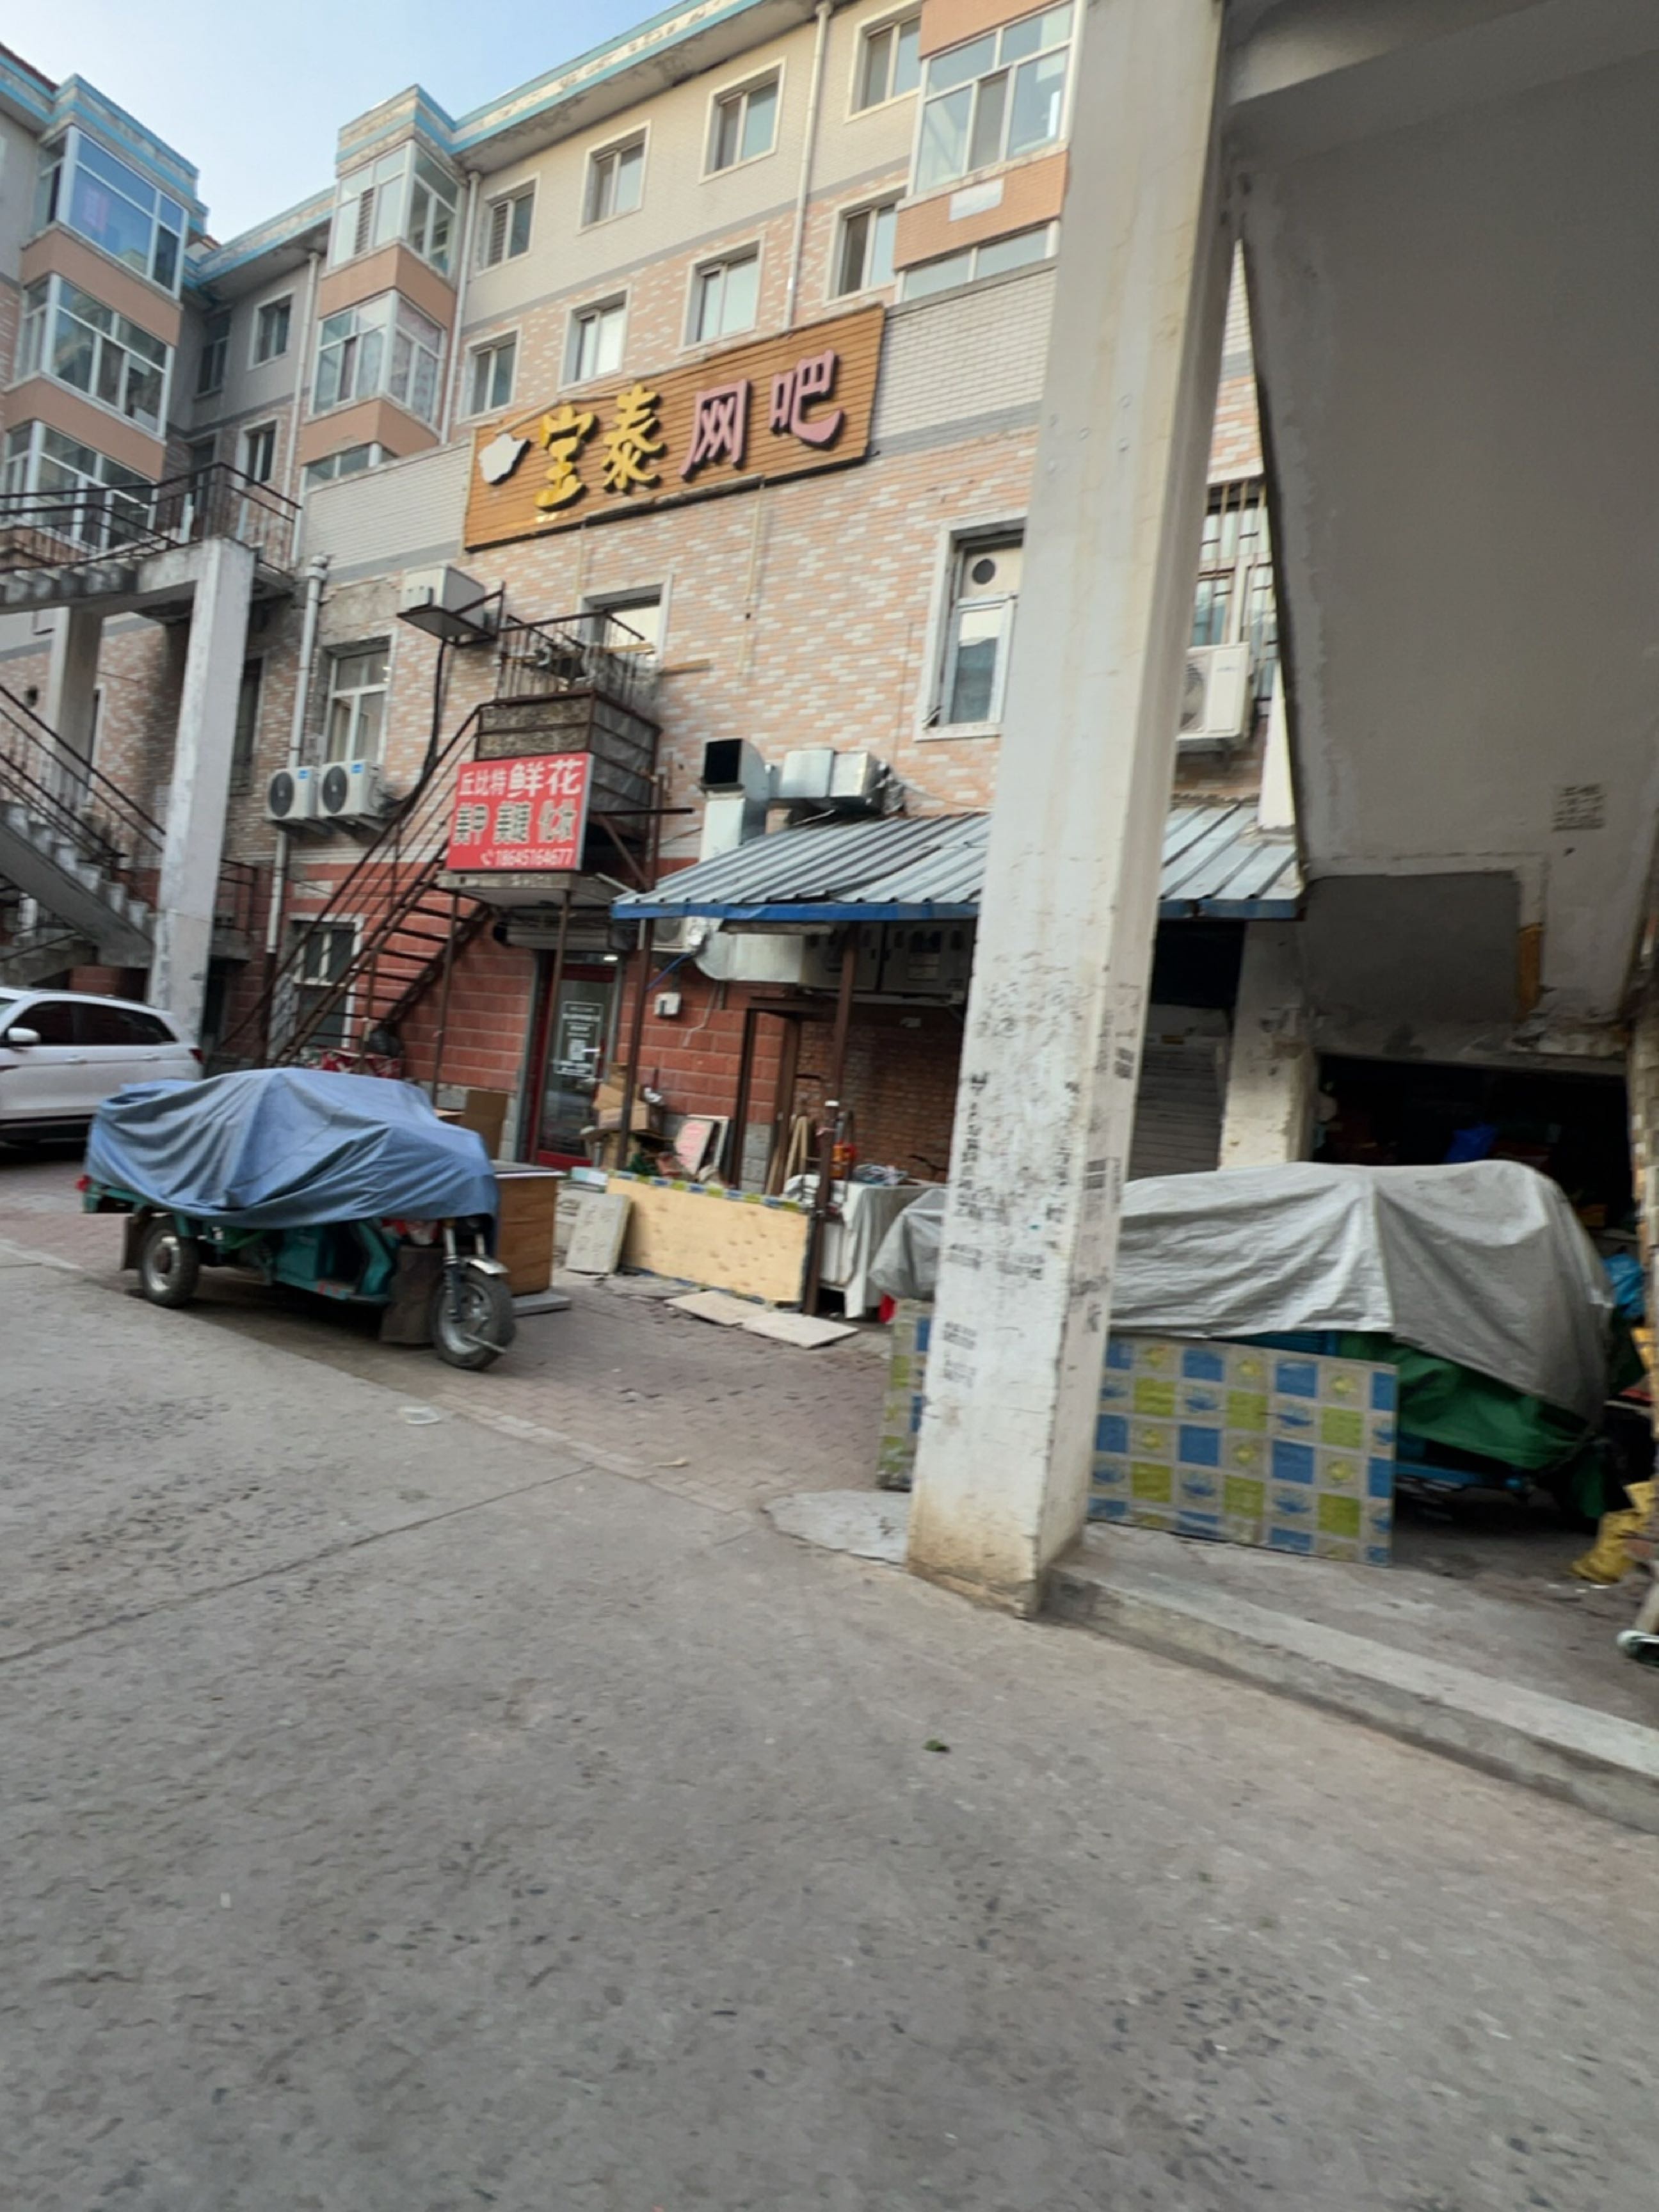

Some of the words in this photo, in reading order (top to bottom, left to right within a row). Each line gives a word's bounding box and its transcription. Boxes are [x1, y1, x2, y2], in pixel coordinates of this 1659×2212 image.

[534, 349, 845, 510] 宝泰网吧
[458, 759, 584, 798] 丘比特鲜花
